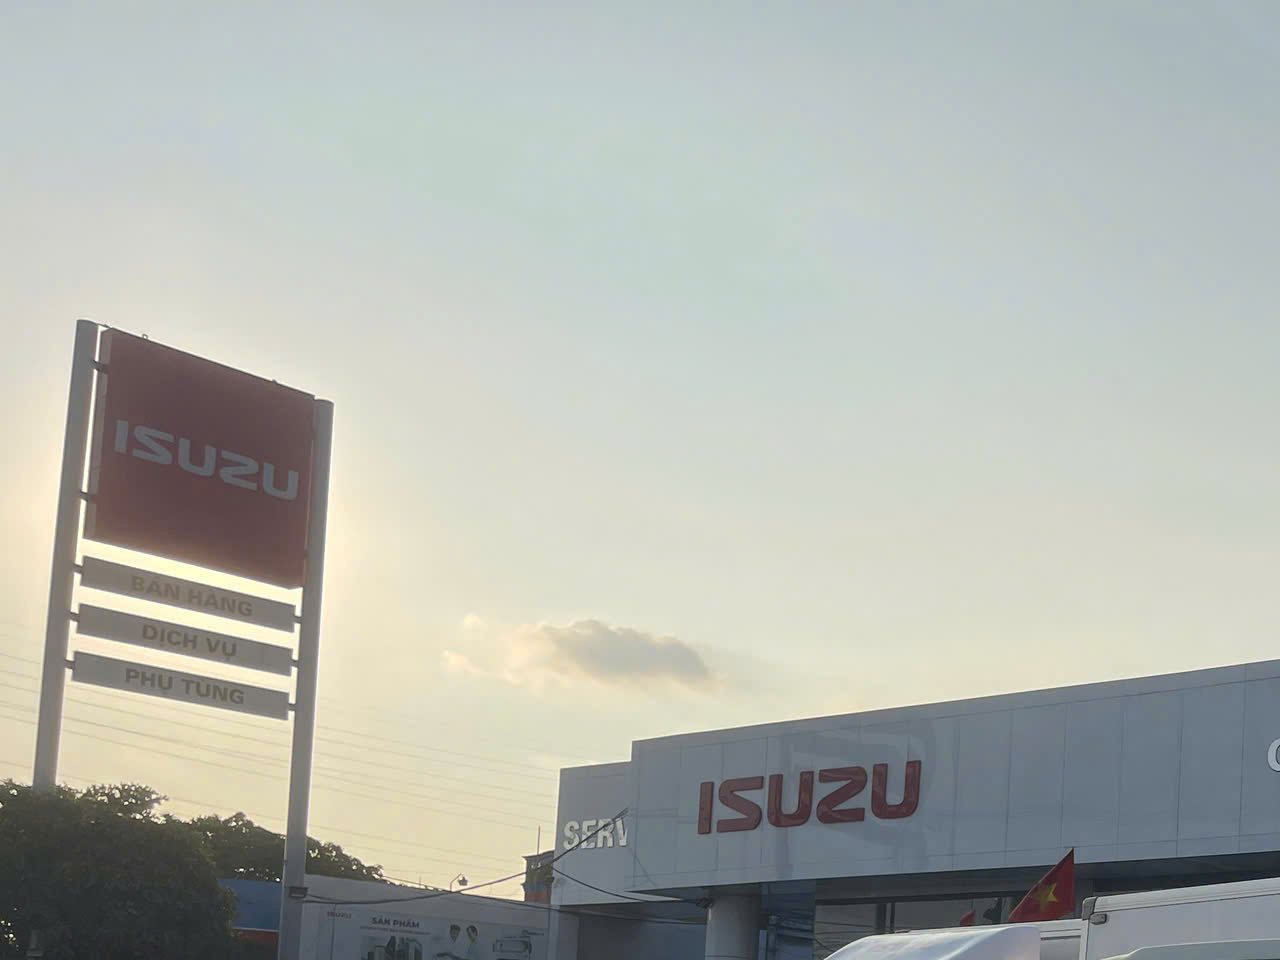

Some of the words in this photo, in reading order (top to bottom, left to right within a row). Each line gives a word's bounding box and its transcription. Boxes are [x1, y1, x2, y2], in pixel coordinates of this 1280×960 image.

[113, 420, 300, 501] ISUZU
[206, 638, 237, 661] VỤ
[125, 668, 173, 695] PHỤ
[697, 759, 922, 835] ISUZU
